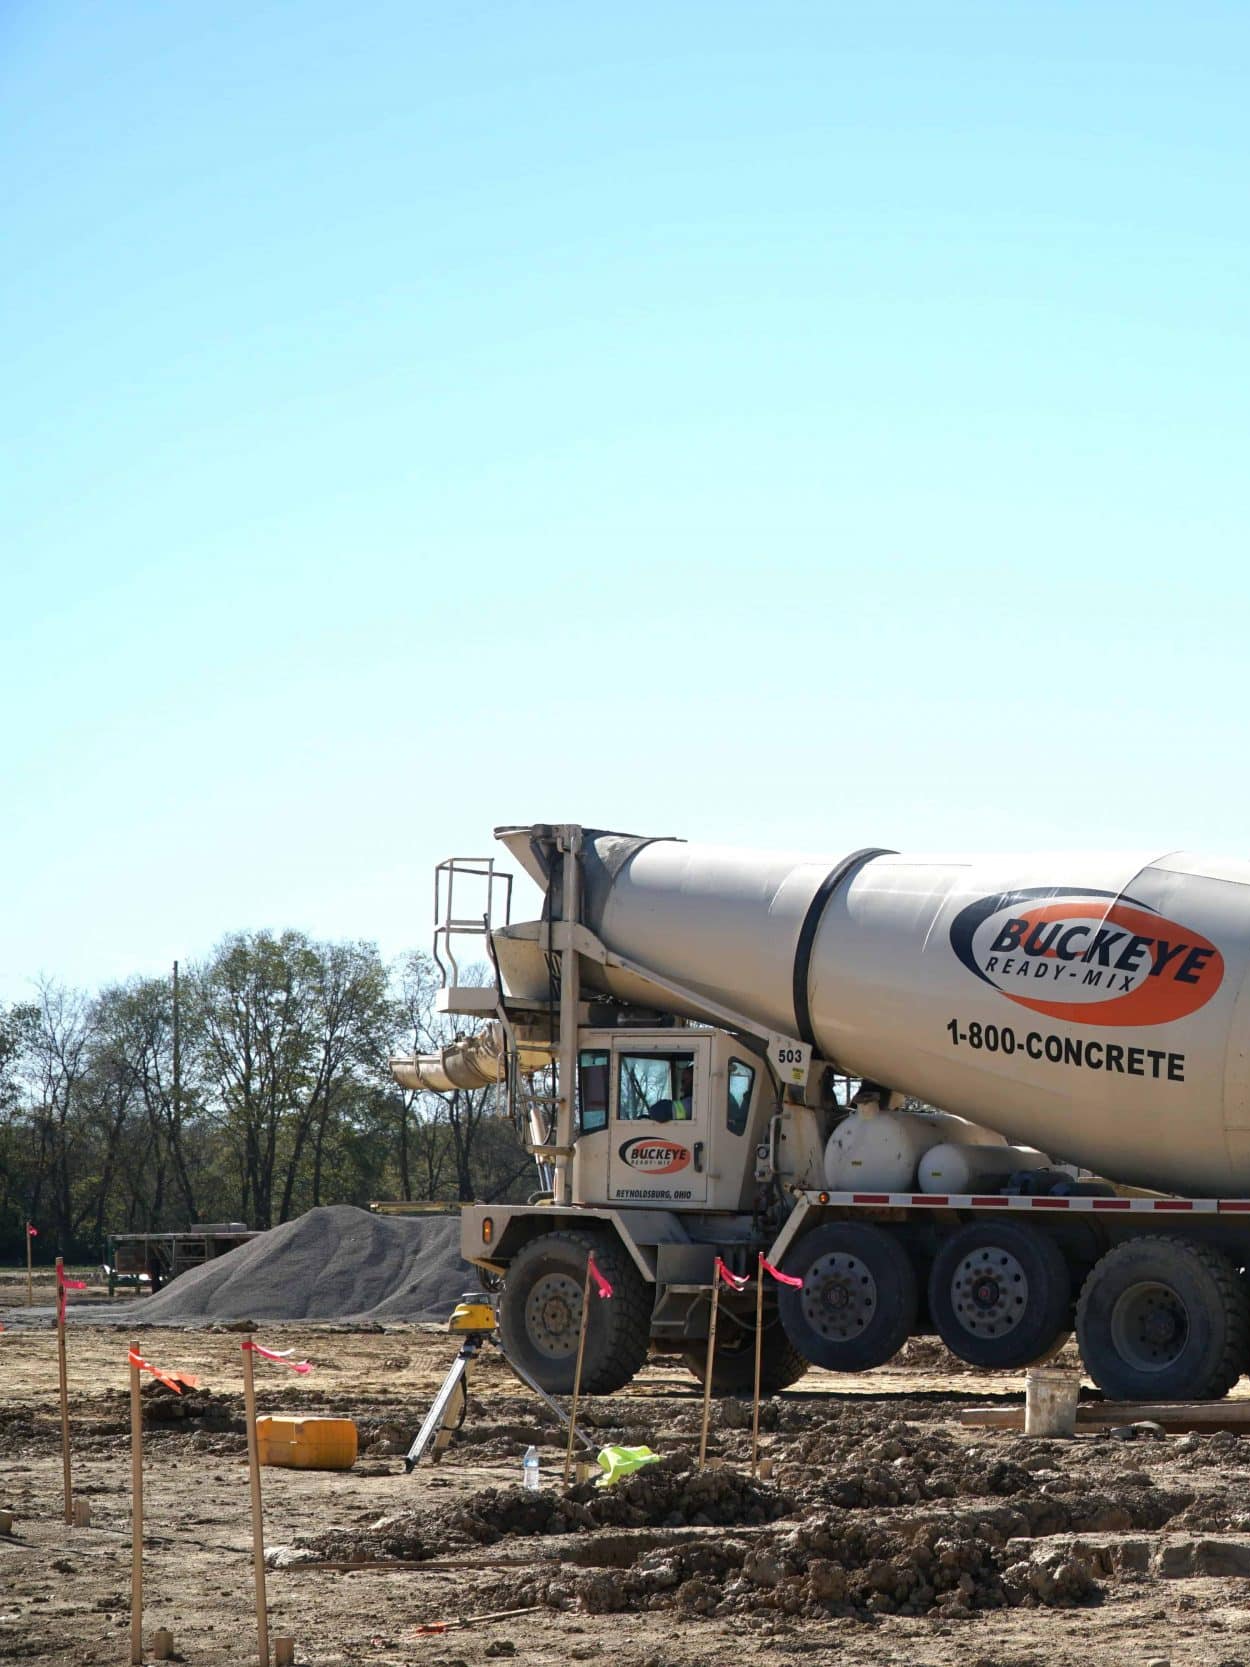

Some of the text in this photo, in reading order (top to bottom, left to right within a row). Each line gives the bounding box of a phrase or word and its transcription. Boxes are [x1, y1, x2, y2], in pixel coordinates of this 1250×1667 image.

[989, 918, 1215, 984] BUCKEYE
[985, 956, 1136, 992] READY-MIX
[778, 1049, 802, 1063] 503
[946, 1018, 1185, 1082] 1-800-CONCRETE
[630, 1148, 688, 1161] BUCKEYE
[616, 1189, 692, 1200] REYNOLDSBURG, OHIO
